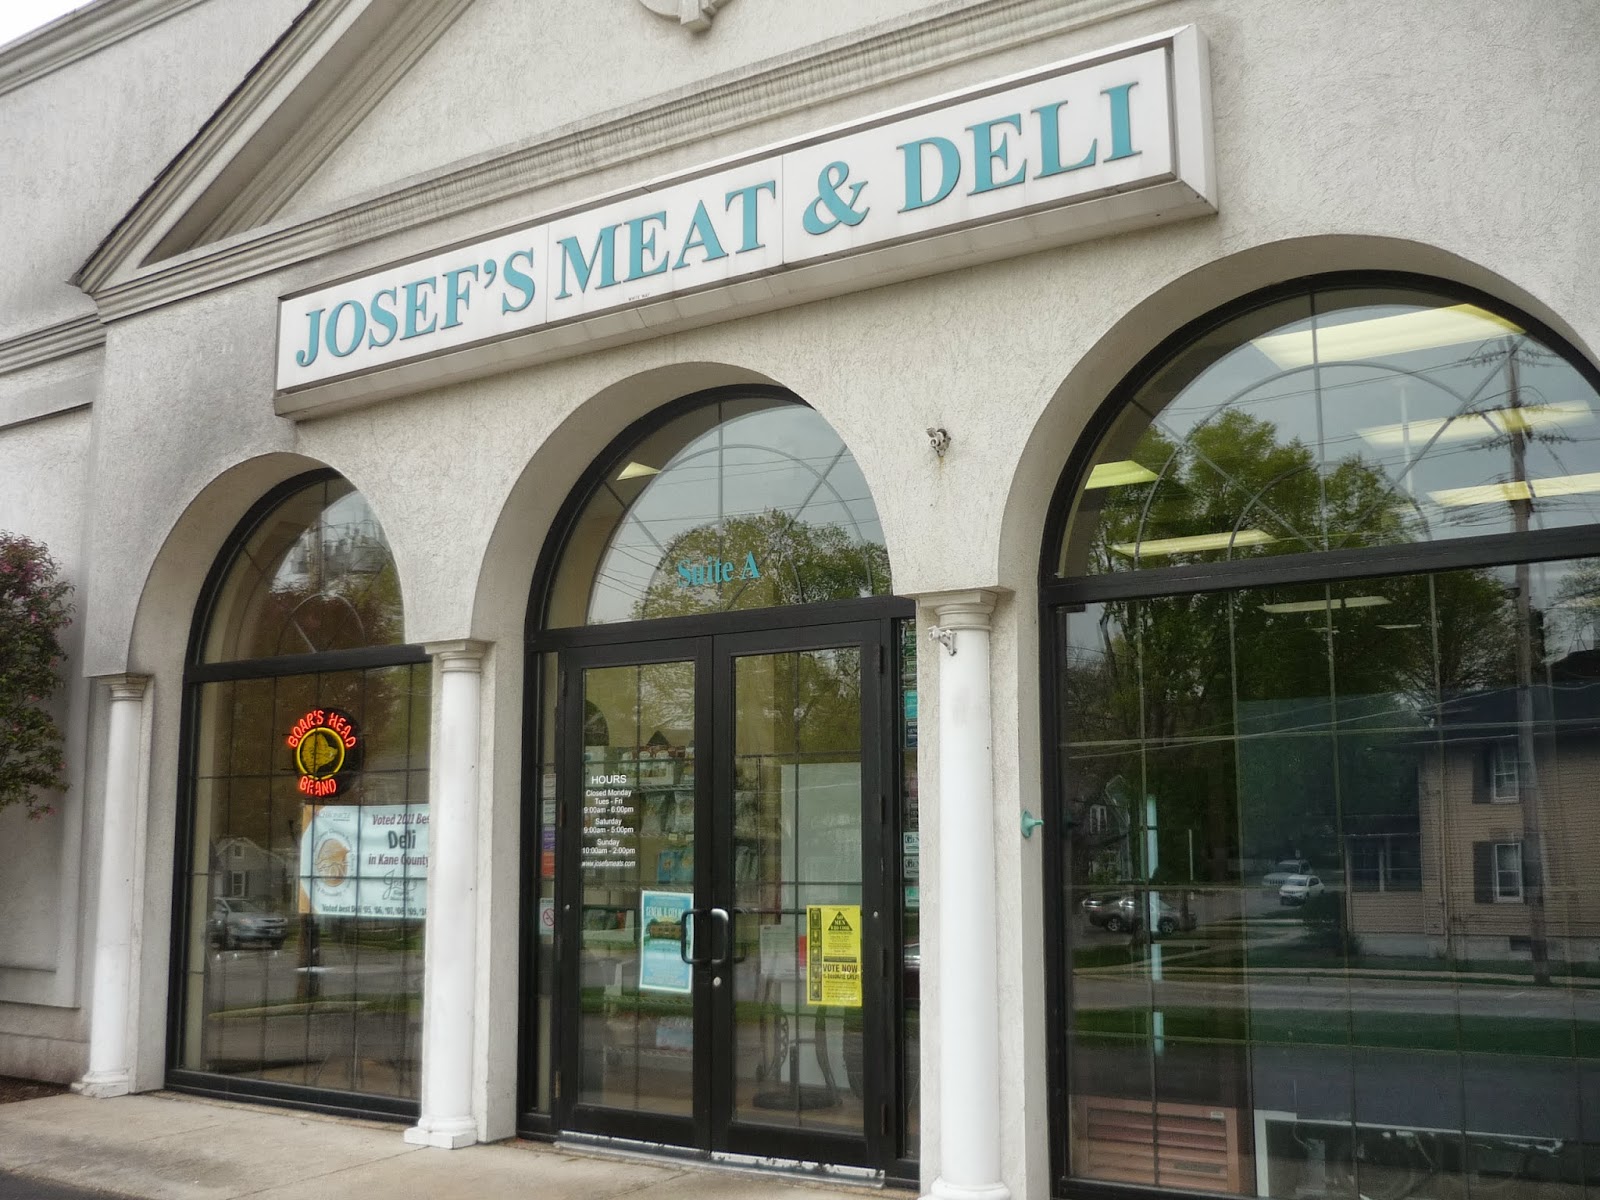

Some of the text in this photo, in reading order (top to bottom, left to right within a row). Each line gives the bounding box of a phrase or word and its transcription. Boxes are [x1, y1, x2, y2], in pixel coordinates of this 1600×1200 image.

[296, 82, 1142, 367] JOSEF'S MEAT & DELI
[677, 551, 760, 587] Suite A
[288, 710, 356, 748] BOAR'S HEAD
[591, 774, 627, 785] HOURS
[299, 776, 336, 796] BRAND
[586, 789, 632, 797] Closed Monday
[611, 805, 634, 814] 6:00pm
[372, 813, 429, 825] Voted 2011 Bes
[595, 817, 622, 826] Saturday
[611, 826, 634, 834] 5:00pm
[388, 829, 416, 849] Deli
[597, 838, 620, 846] Sunday
[612, 847, 636, 855] 2:00pm
[368, 853, 428, 867] in Kane County
[351, 904, 361, 913] Dli
[823, 963, 858, 973] VOTE NOW
